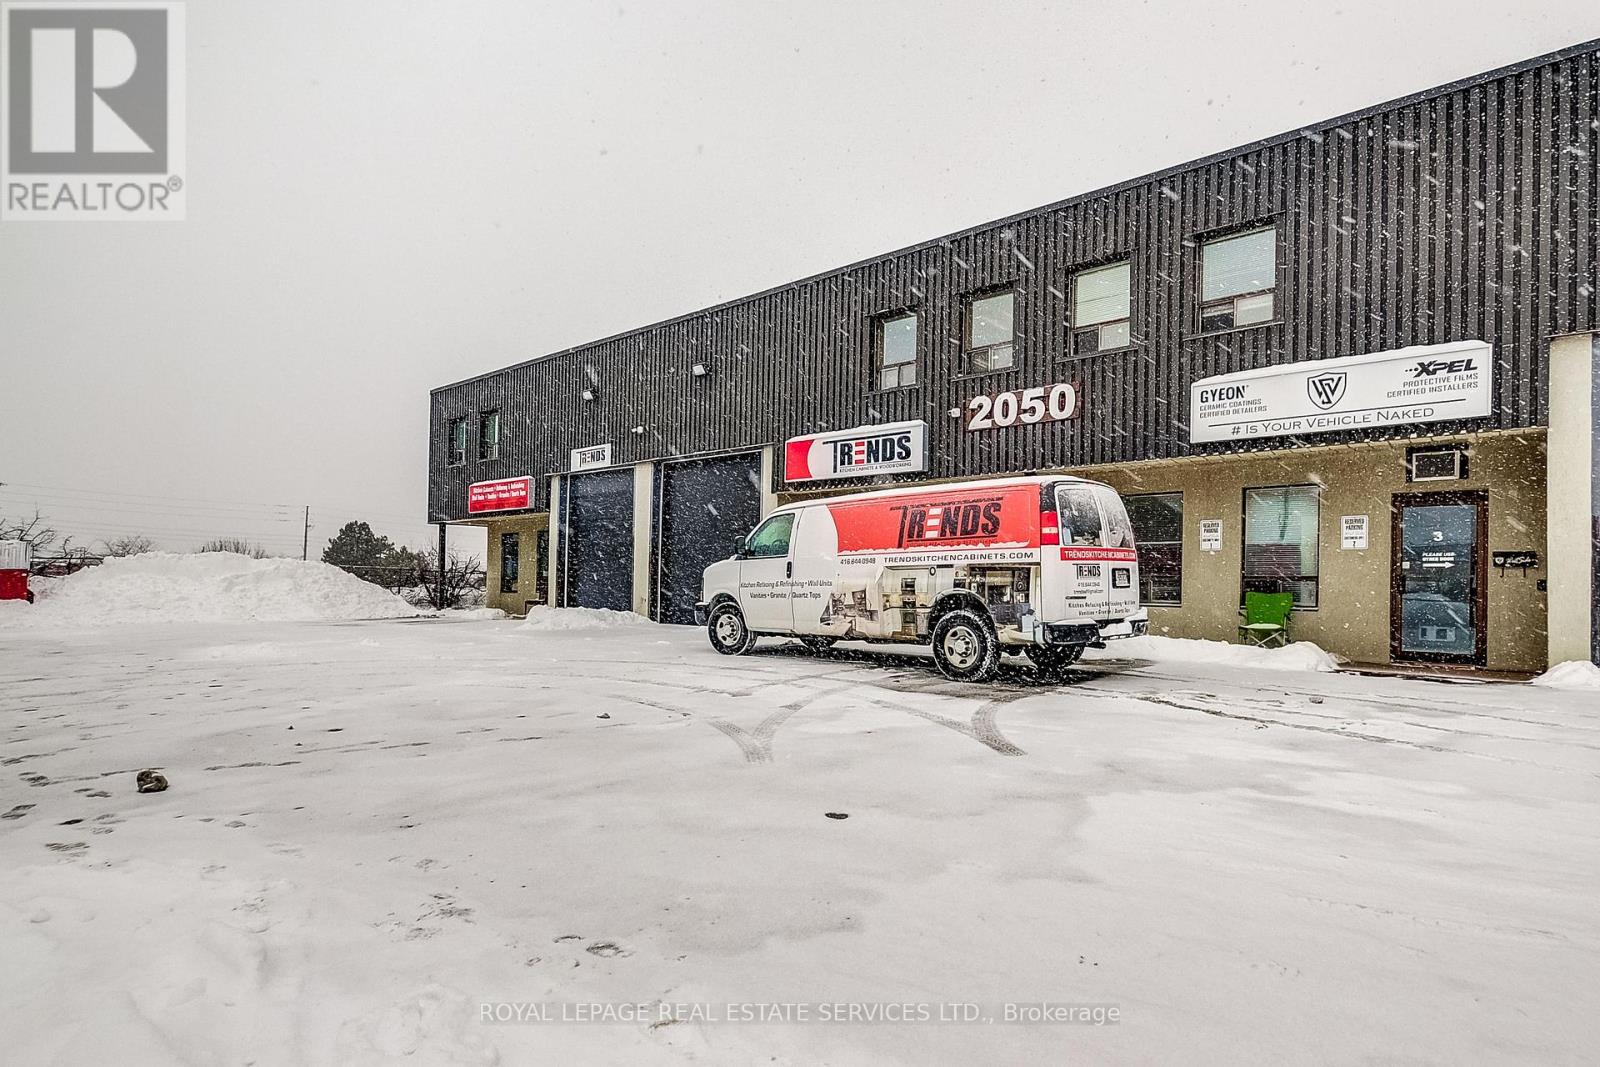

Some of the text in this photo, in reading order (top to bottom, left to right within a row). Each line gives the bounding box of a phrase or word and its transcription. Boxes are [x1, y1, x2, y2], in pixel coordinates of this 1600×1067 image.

[1413, 358, 1478, 378] XPEL
[1403, 372, 1479, 388] PROTECTIVE FILMS
[1200, 385, 1246, 403] GYEON
[1387, 381, 1479, 398] CERTIFIED INSTALLERS
[968, 383, 1076, 430] 2050
[1200, 398, 1262, 412] CERAMIC COATINGS
[1200, 405, 1268, 419] CERTIFIED DETAILERS
[576, 447, 606, 467] TRENDS
[823, 430, 912, 473] TRENDS
[890, 497, 1004, 549] TRENDS
[1433, 531, 1443, 541] 3
[884, 552, 1034, 564] TRENDSKITCHENCABINETS.COM
[1072, 563, 1101, 579] TRENDS
[809, 591, 821, 600] Tops
